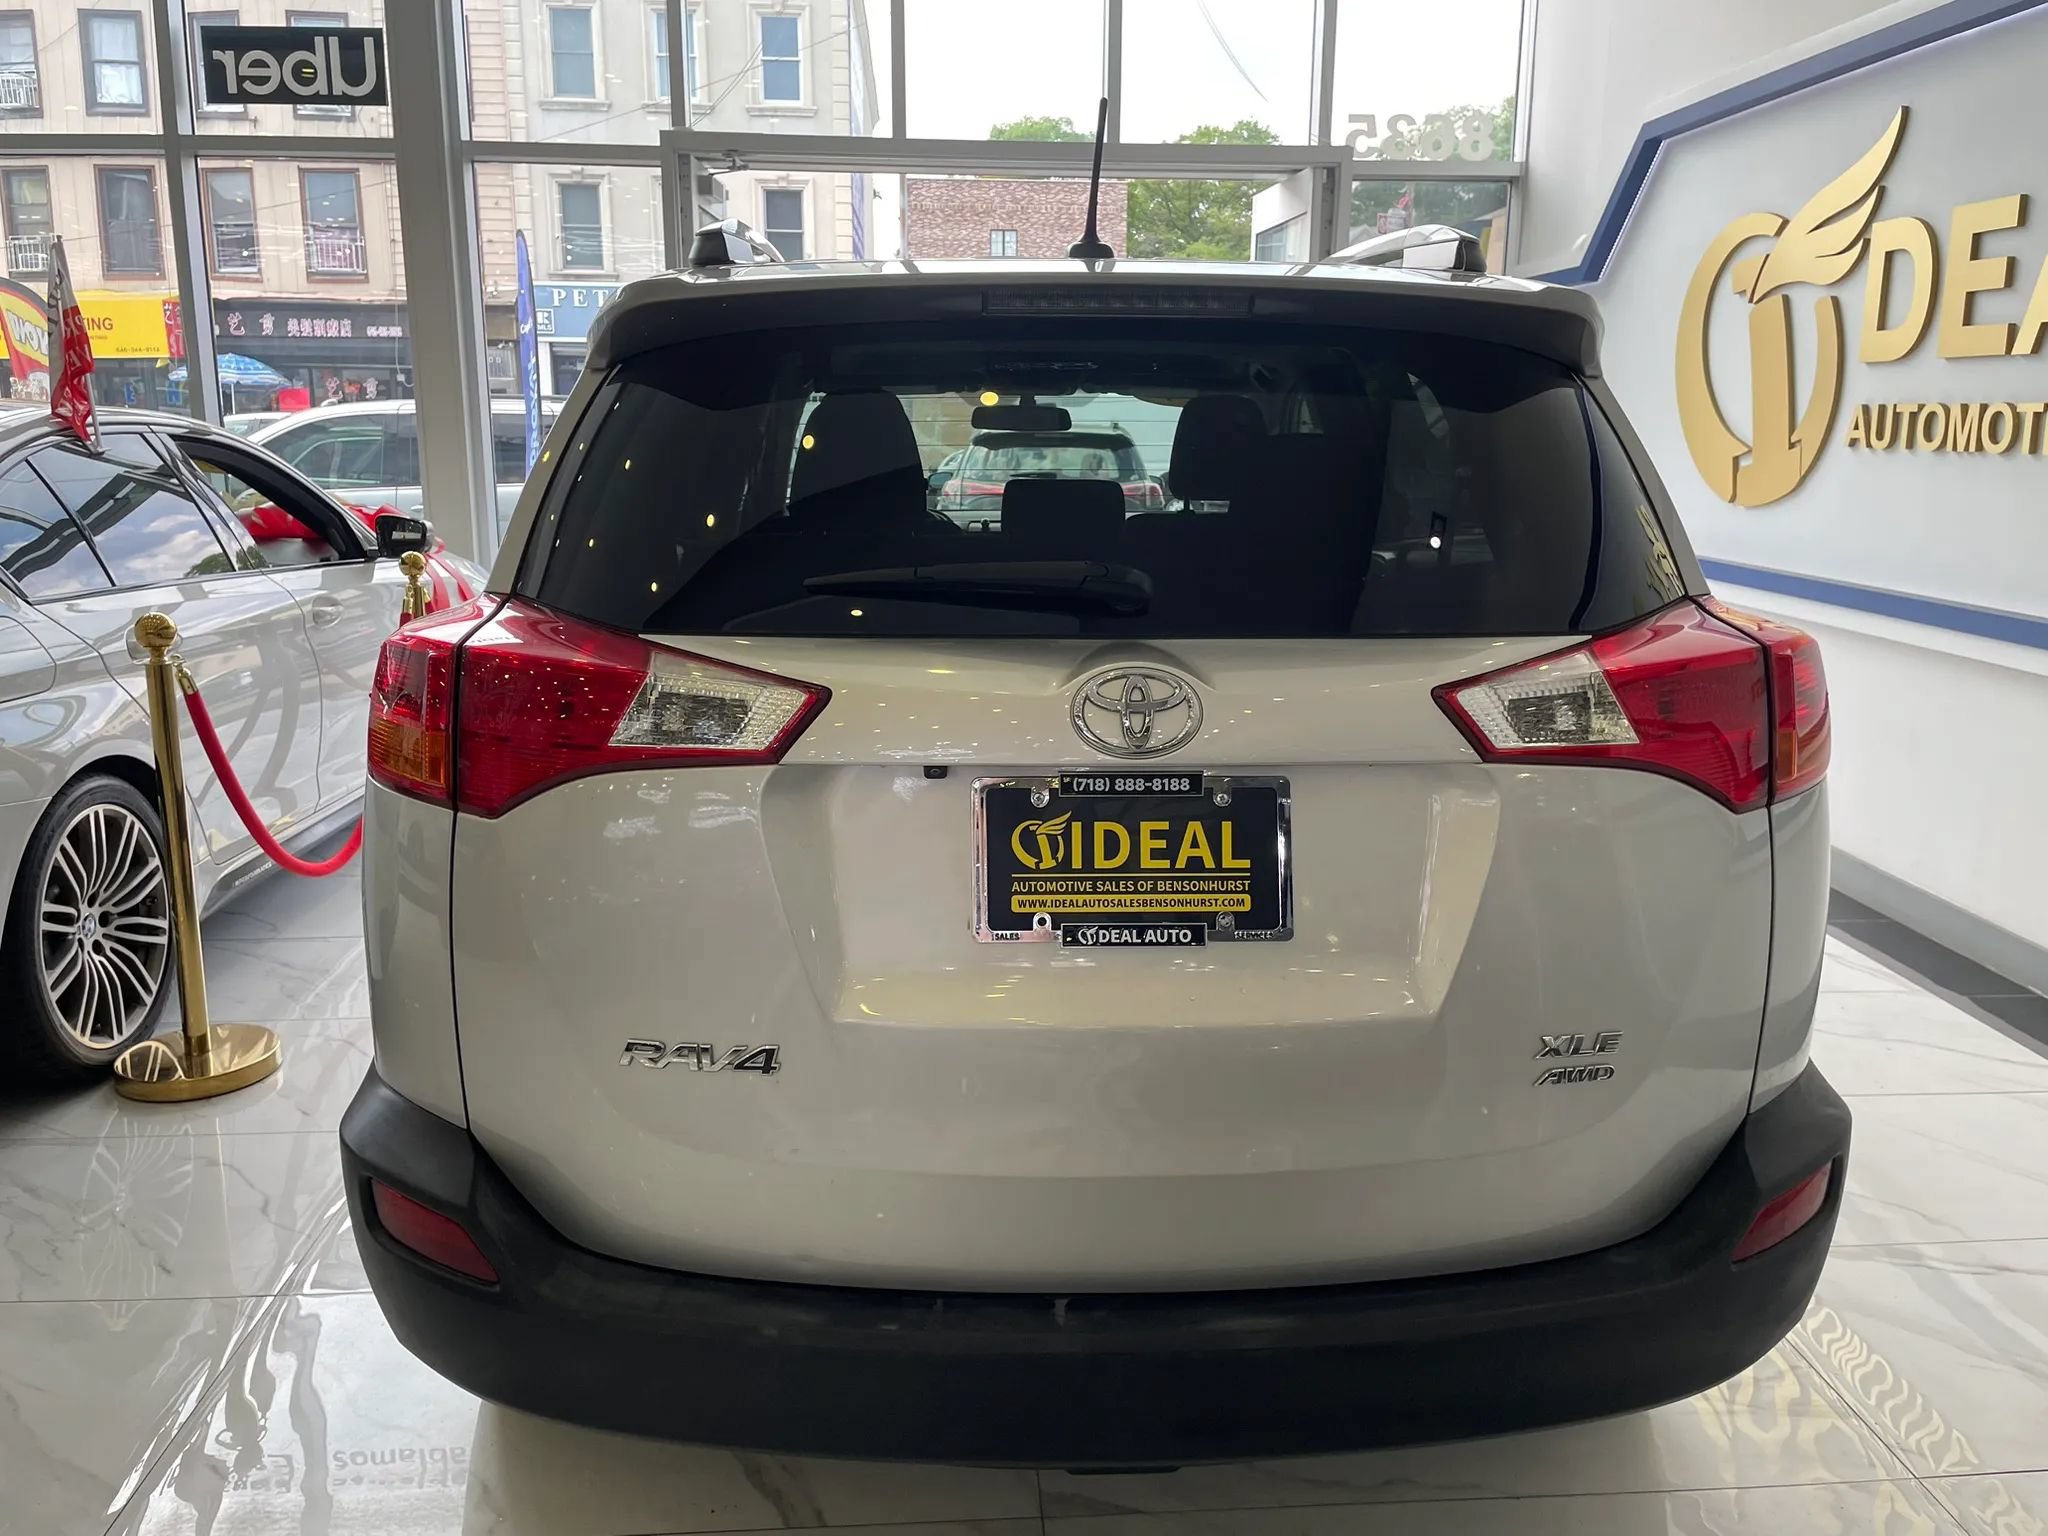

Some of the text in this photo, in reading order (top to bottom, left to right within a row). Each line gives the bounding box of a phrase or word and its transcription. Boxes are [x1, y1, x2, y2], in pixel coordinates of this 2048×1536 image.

[1073, 777, 1110, 792] (718)
[1114, 778, 1190, 792] 888-8188
[1071, 821, 1251, 869] IDEAL
[1011, 880, 1250, 893] AUTOMOTIVE SALES OF BENSONHURST
[1017, 897, 1246, 909] WWW.IDEALAUTOSALESBENSONHURST.COM
[1145, 929, 1192, 943] AUTO
[1532, 1031, 1624, 1060] XLE
[618, 1039, 782, 1076] RAV4
[1531, 1063, 1615, 1087] AWD
